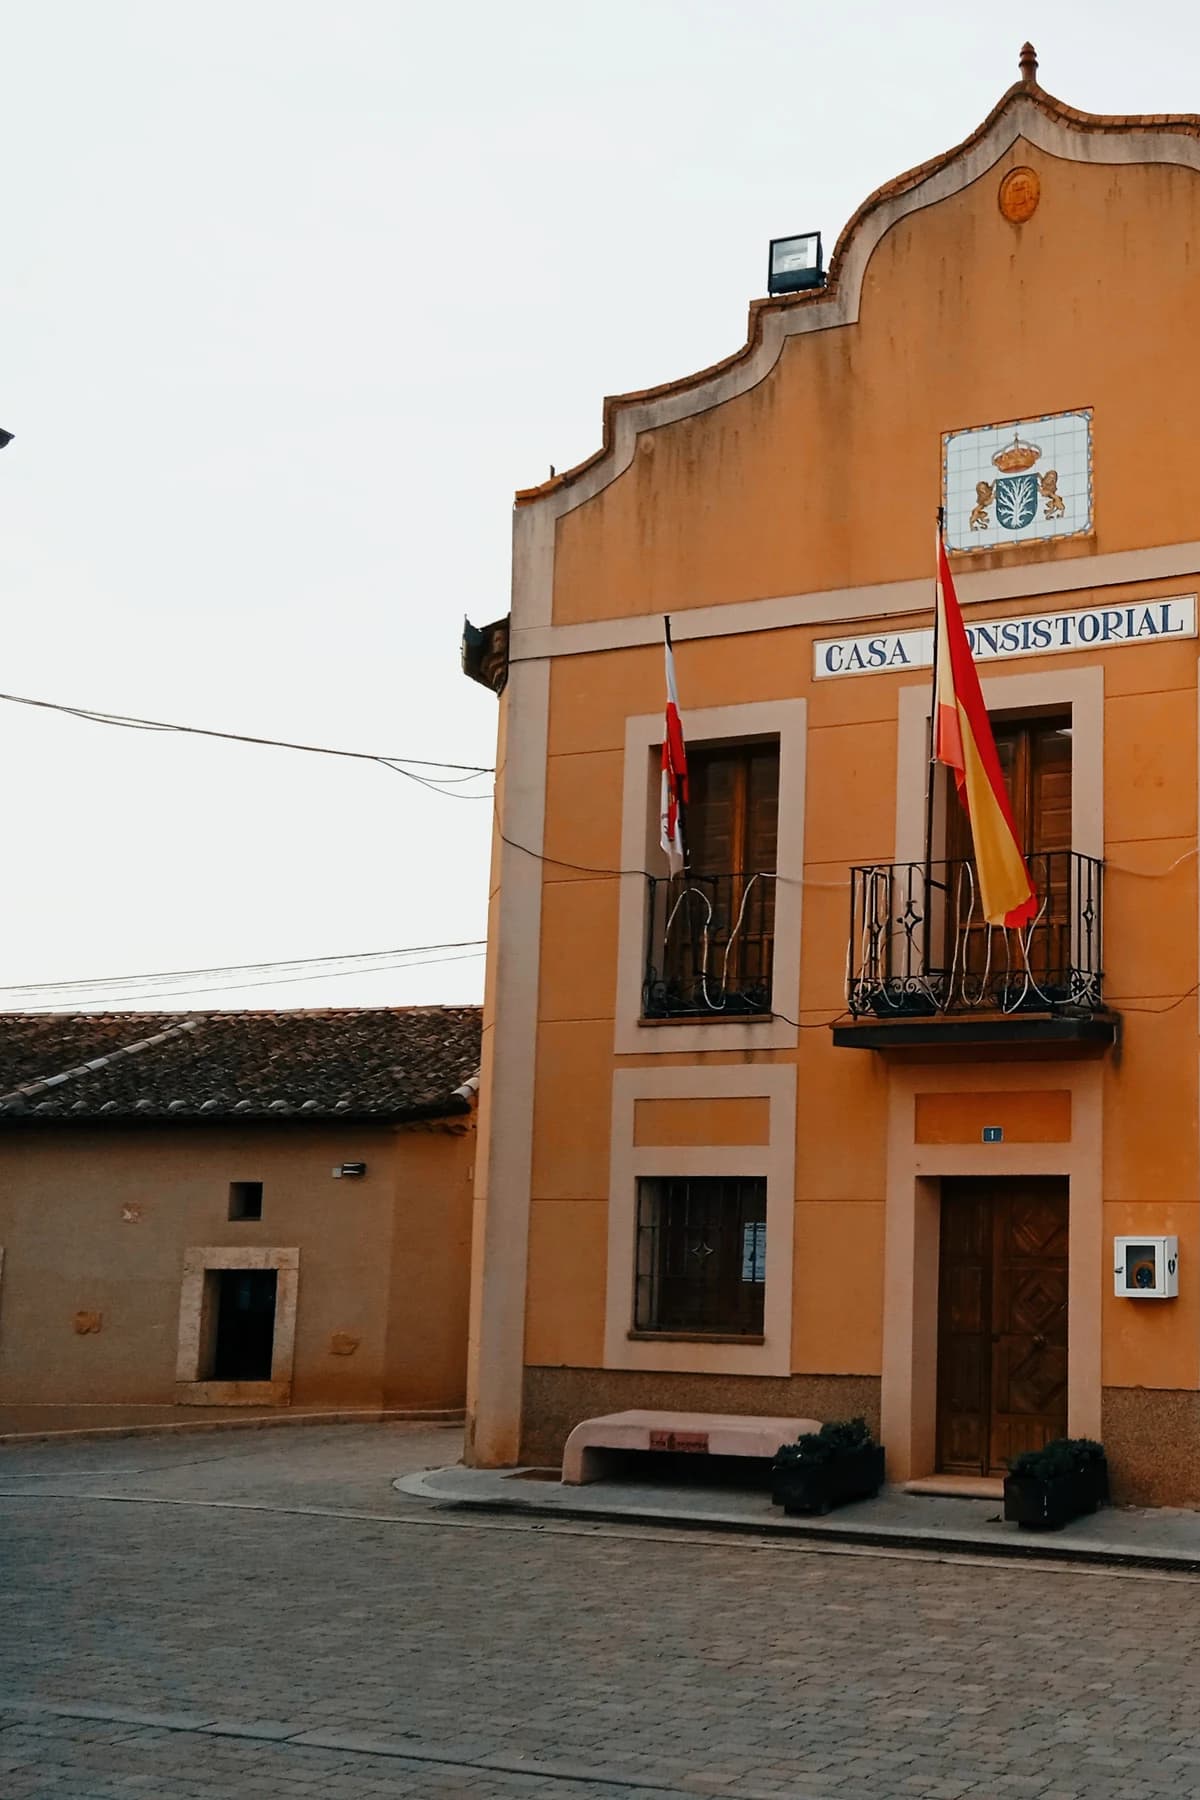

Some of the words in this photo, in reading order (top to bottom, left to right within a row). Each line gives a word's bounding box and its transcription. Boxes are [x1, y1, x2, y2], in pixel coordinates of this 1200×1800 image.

[825, 637, 911, 672] CASA
[962, 604, 1184, 655] NSISTORIAL
[990, 1129, 995, 1140] 1
